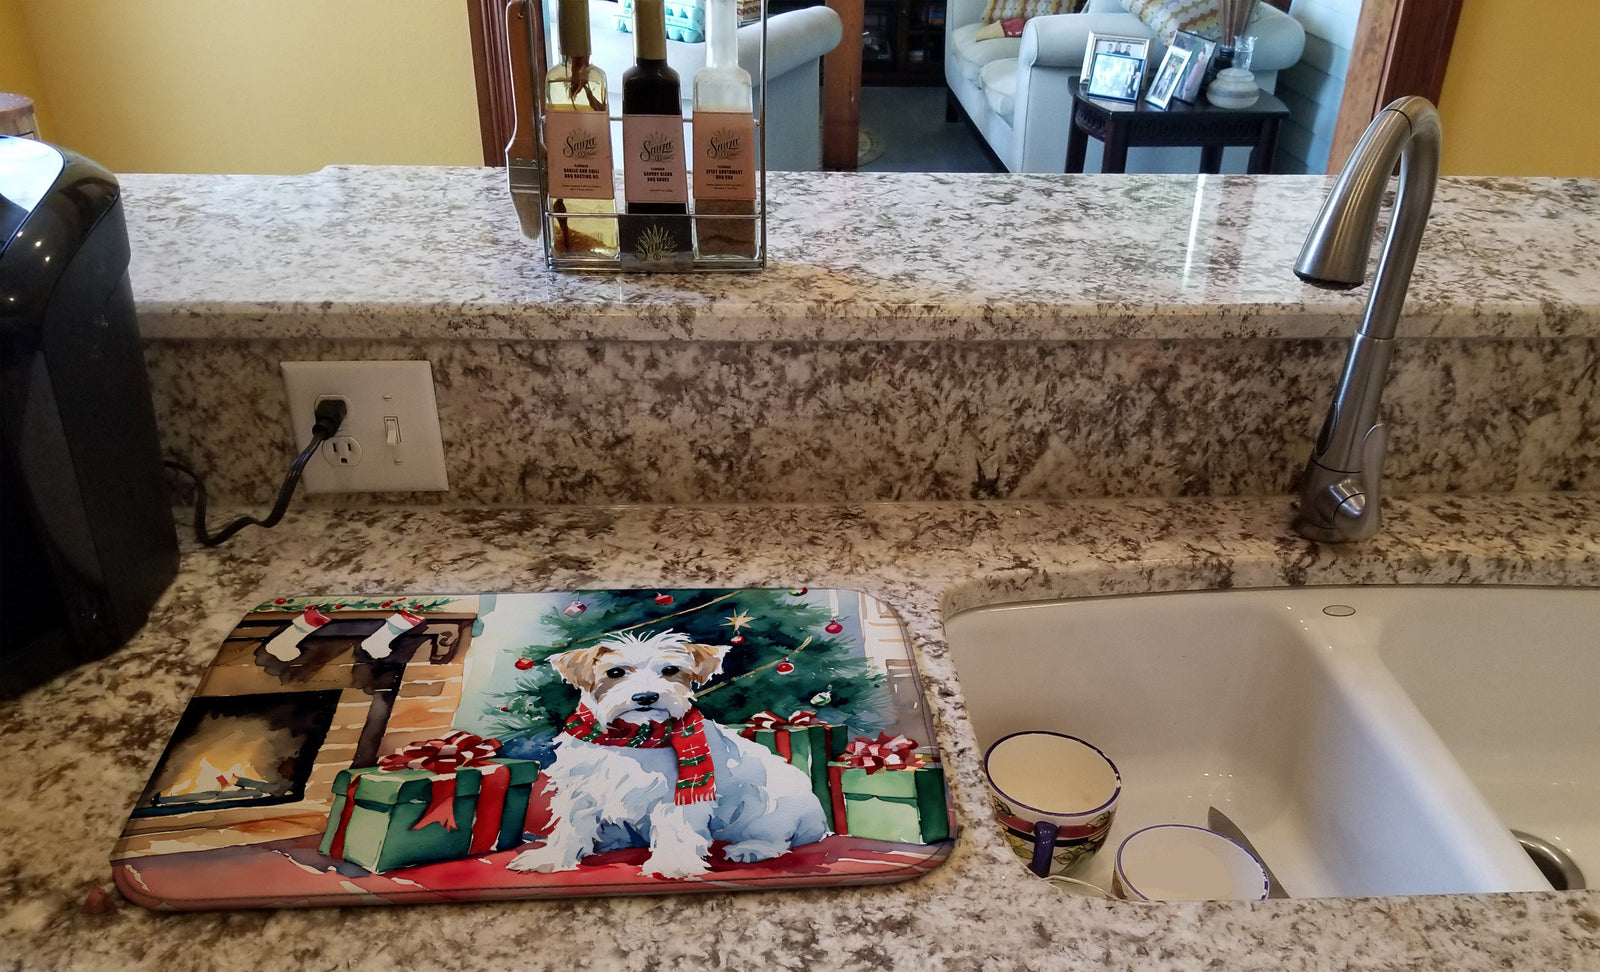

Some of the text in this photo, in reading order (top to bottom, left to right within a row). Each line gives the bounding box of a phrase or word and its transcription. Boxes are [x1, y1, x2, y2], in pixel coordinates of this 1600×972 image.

[562, 136, 597, 158] Sauza
[640, 140, 673, 162] Sauza
[706, 136, 740, 159] Sauza
